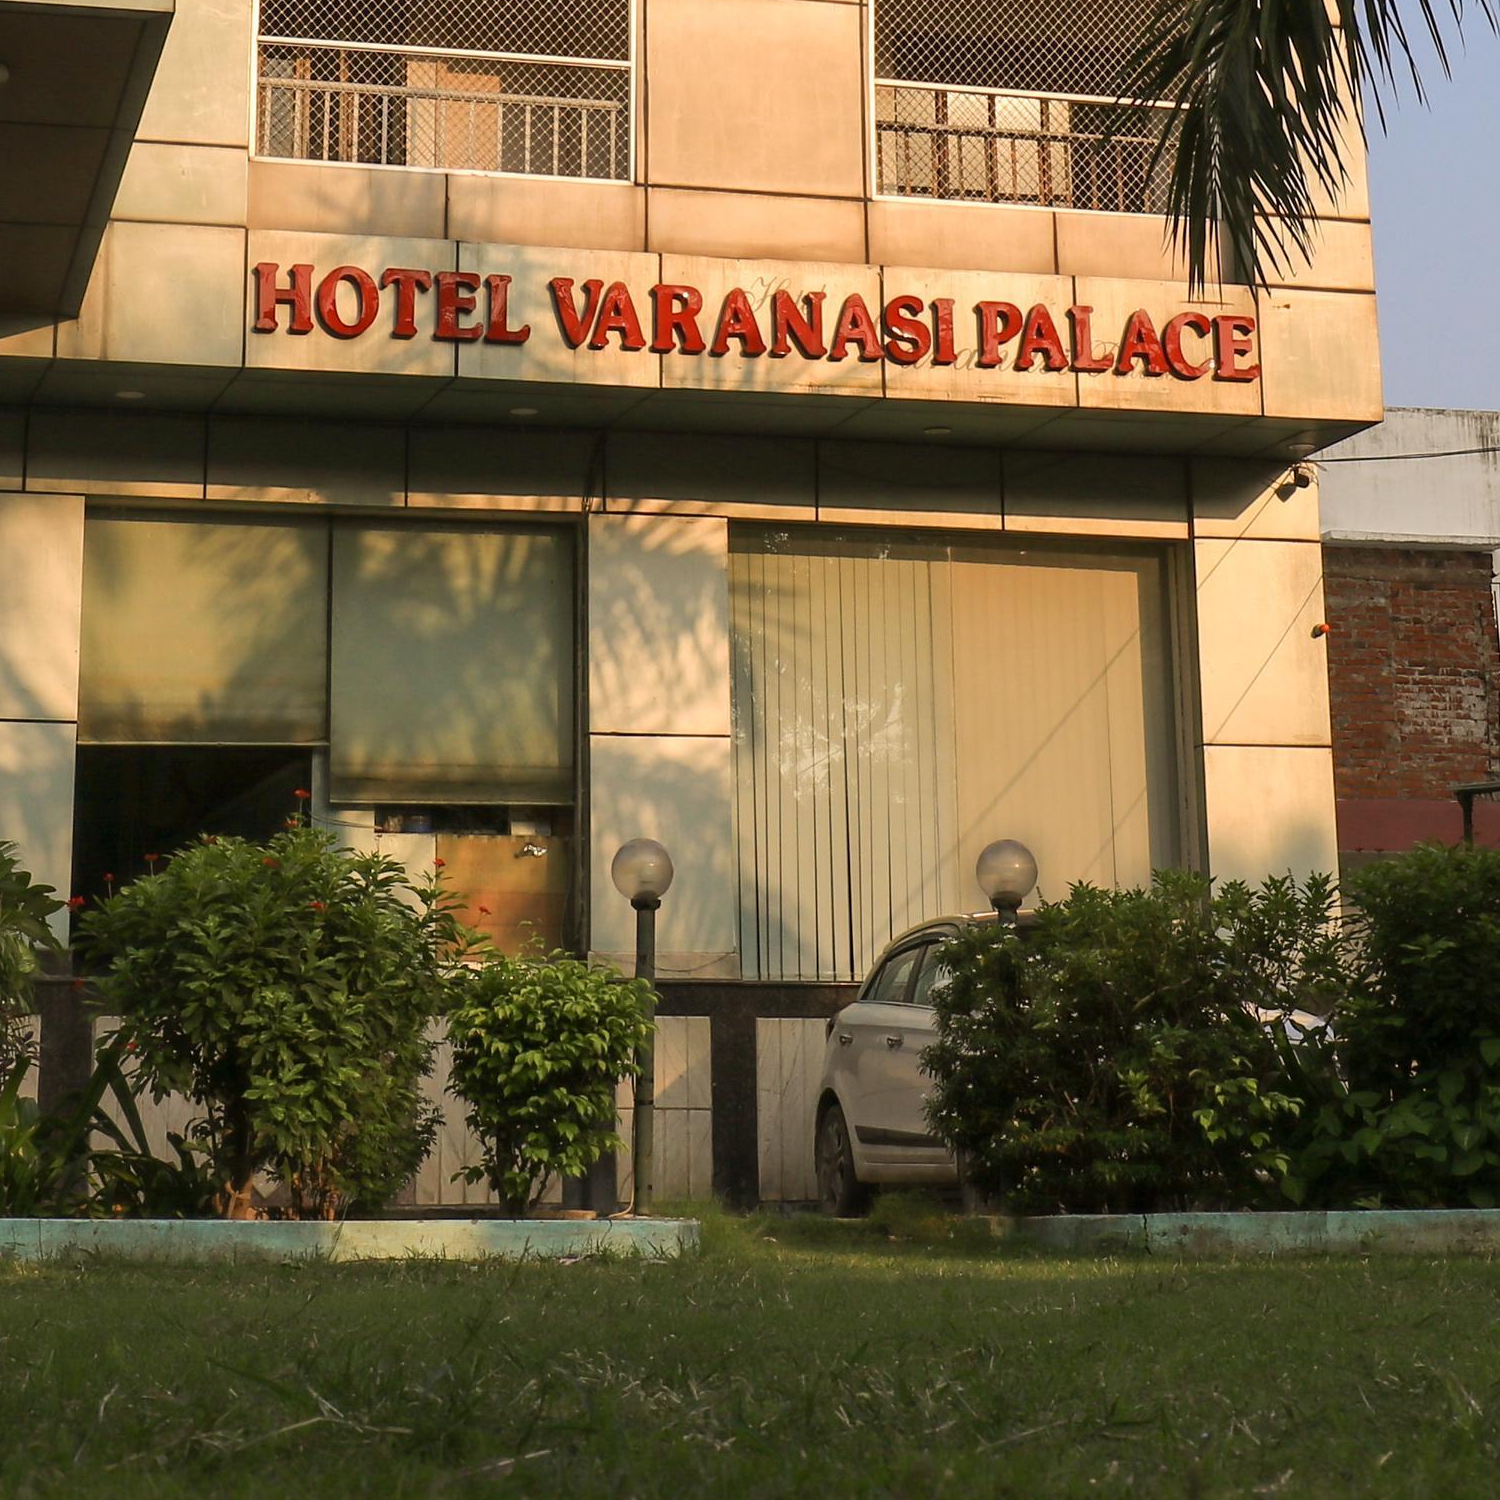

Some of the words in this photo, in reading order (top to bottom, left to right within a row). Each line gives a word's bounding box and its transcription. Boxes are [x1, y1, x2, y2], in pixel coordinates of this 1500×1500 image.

[252, 262, 531, 345] HOTEL
[547, 277, 957, 366] VARANASI
[974, 300, 1261, 383] PALACE
